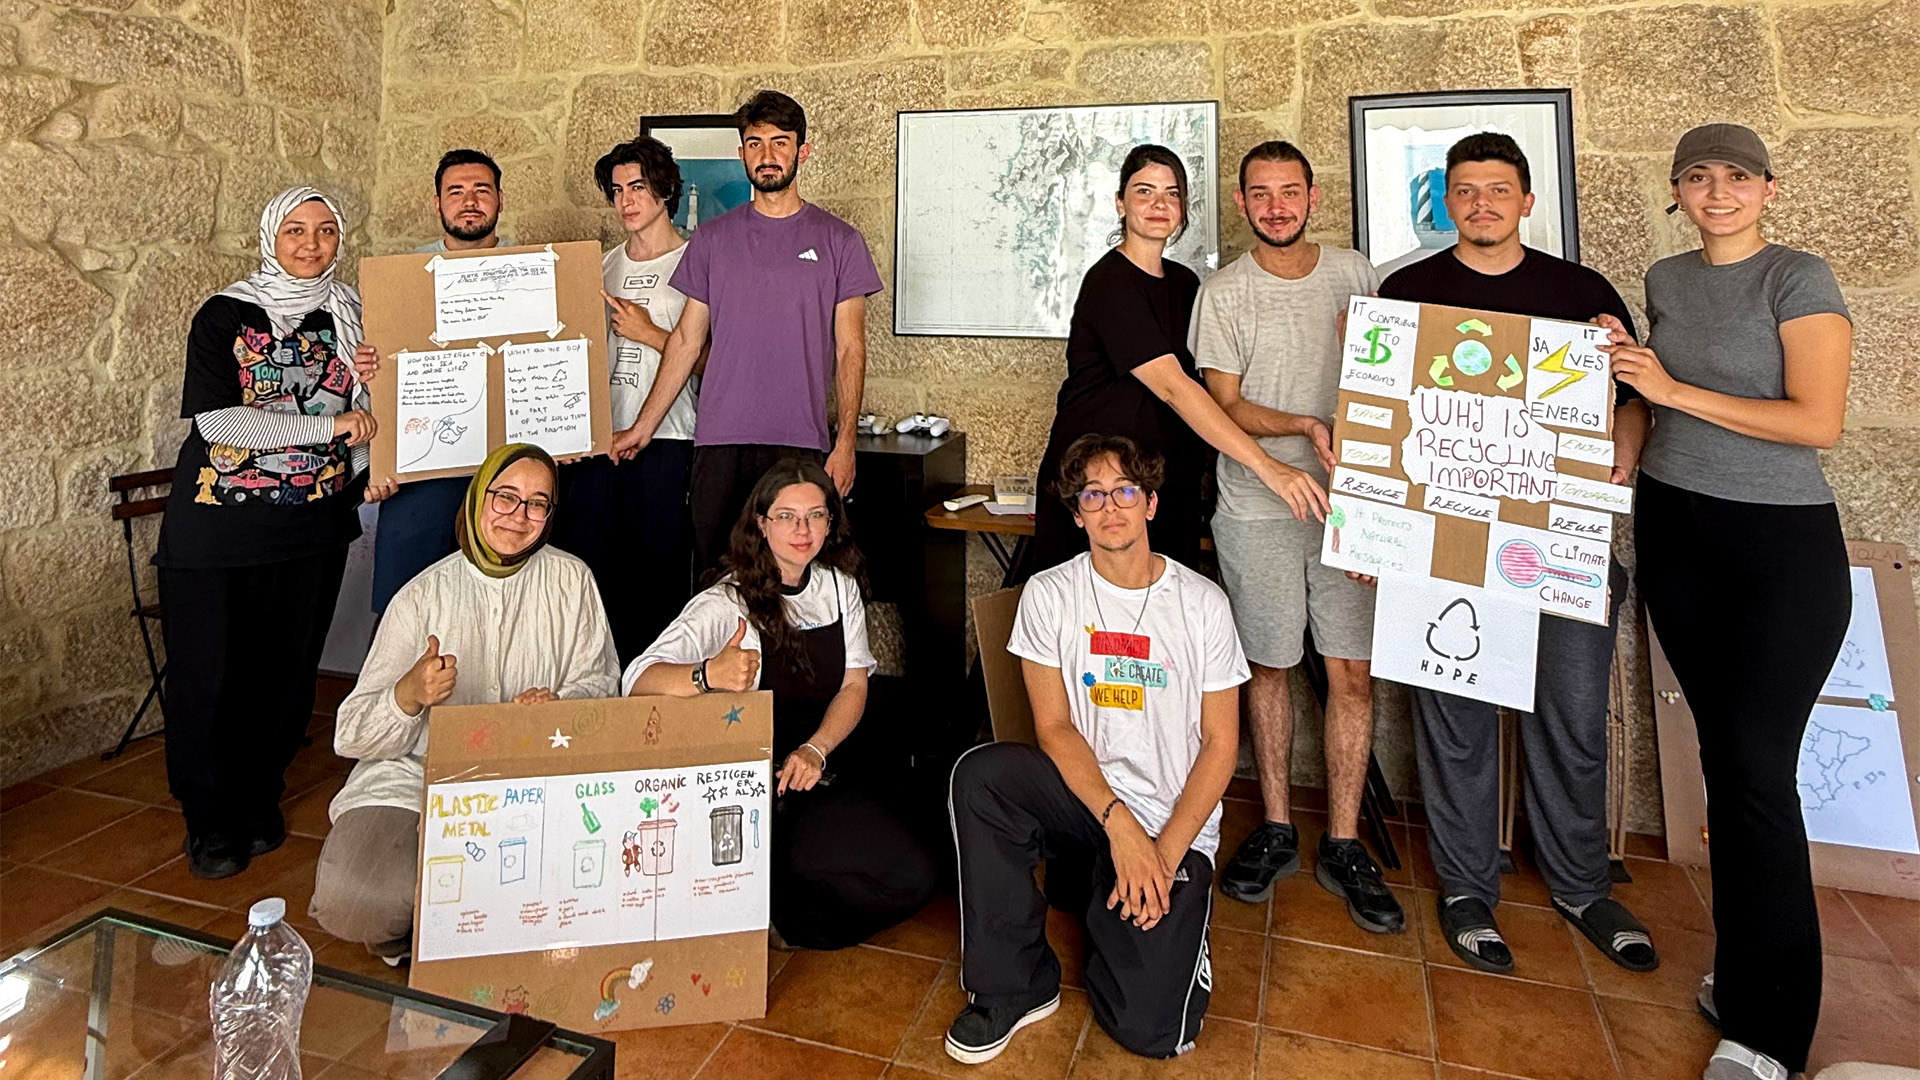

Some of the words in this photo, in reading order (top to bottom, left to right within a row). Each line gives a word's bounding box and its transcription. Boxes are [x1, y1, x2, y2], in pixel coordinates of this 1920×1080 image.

[1352, 301, 1367, 316] IT
[1384, 333, 1400, 346] TO
[1583, 329, 1598, 340] IT
[1349, 344, 1368, 354] THE
[250, 361, 281, 381] TOM
[1345, 369, 1395, 387] ECONOMY
[254, 380, 280, 395] CAT
[1352, 407, 1390, 421] SAVE
[1421, 392, 1484, 433] WHY
[1505, 409, 1529, 438] IS
[1530, 401, 1600, 427] ENERGY
[1344, 448, 1389, 464] TODAY
[1416, 428, 1555, 472] RECYCLING
[1560, 439, 1612, 456] ENJOY
[289, 454, 325, 472] TUNA
[1341, 477, 1405, 500] REDUCE
[1430, 461, 1557, 498] IMPORTANT
[1551, 517, 1608, 534] REUSE
[1539, 586, 1592, 609] CHANGE
[1129, 664, 1163, 683] CREATE
[1421, 659, 1478, 685] HDPE
[1094, 687, 1108, 702] WE
[1113, 689, 1138, 704] HELP
[503, 788, 544, 808] PAPER
[576, 782, 616, 799] GLASS
[428, 793, 499, 818] PLASTIC
[442, 822, 491, 838] METAL
